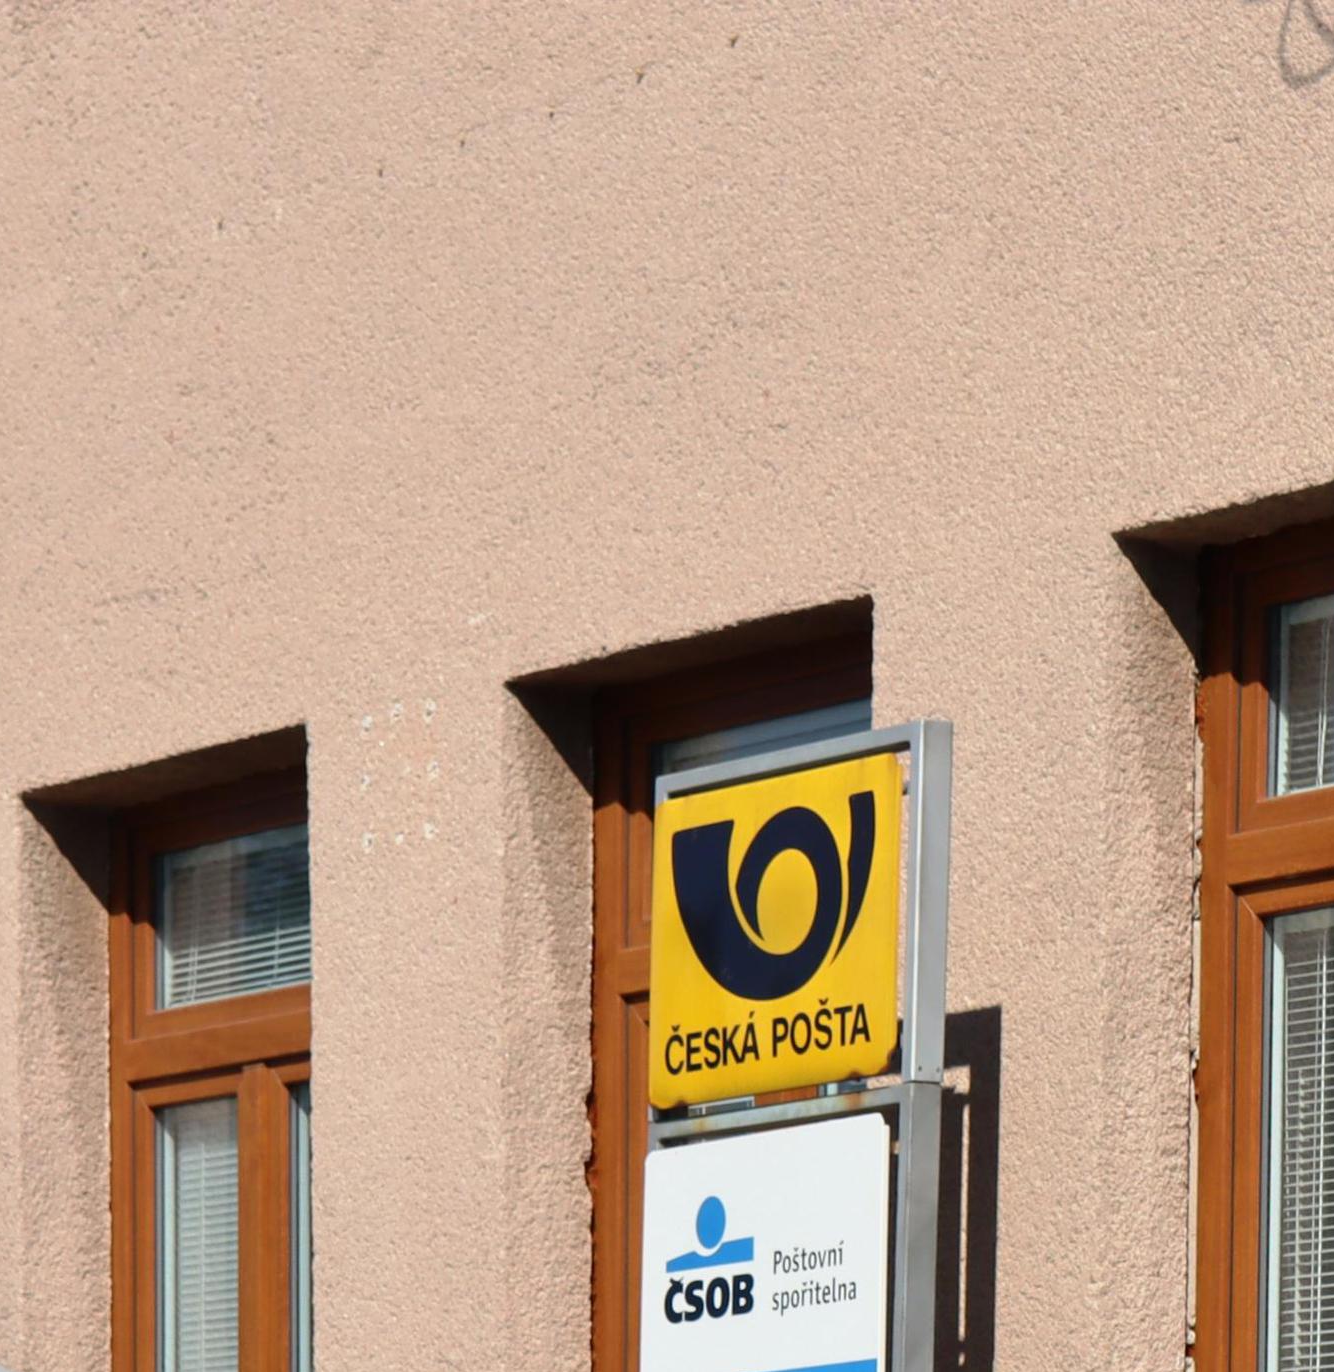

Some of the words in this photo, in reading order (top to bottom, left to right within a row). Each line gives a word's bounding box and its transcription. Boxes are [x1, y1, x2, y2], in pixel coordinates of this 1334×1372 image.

[665, 1011, 759, 1075] ČESKÁ
[772, 998, 871, 1058] POŠTA
[773, 1241, 844, 1275] Poštovní
[664, 1273, 754, 1324] ČSOB
[772, 1277, 857, 1316] spořitelna
